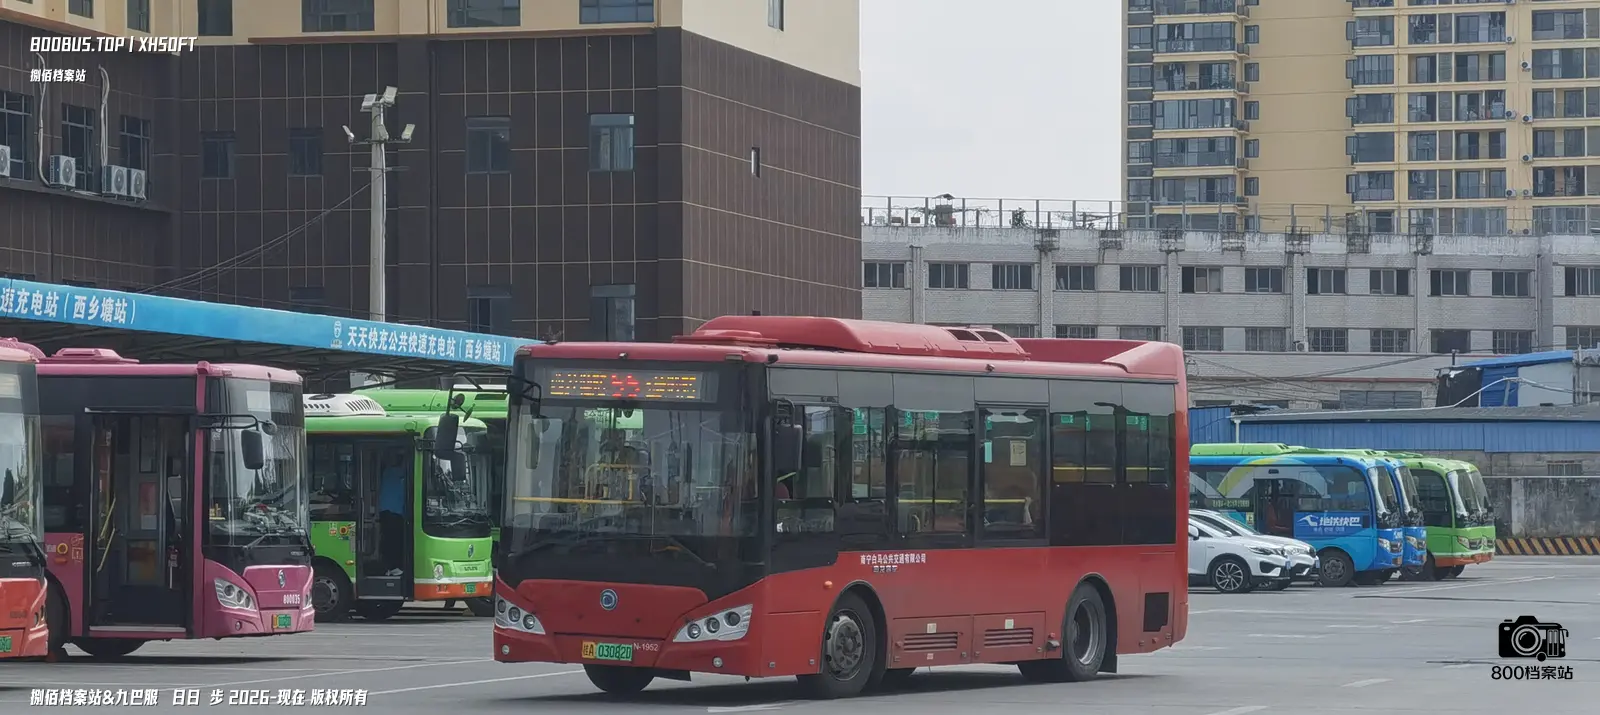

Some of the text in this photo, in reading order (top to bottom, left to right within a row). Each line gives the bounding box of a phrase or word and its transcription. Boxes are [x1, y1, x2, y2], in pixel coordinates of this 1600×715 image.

[860, 553, 926, 565] 南宁白马公共交通有限公司
[633, 642, 659, 652] N-1952
